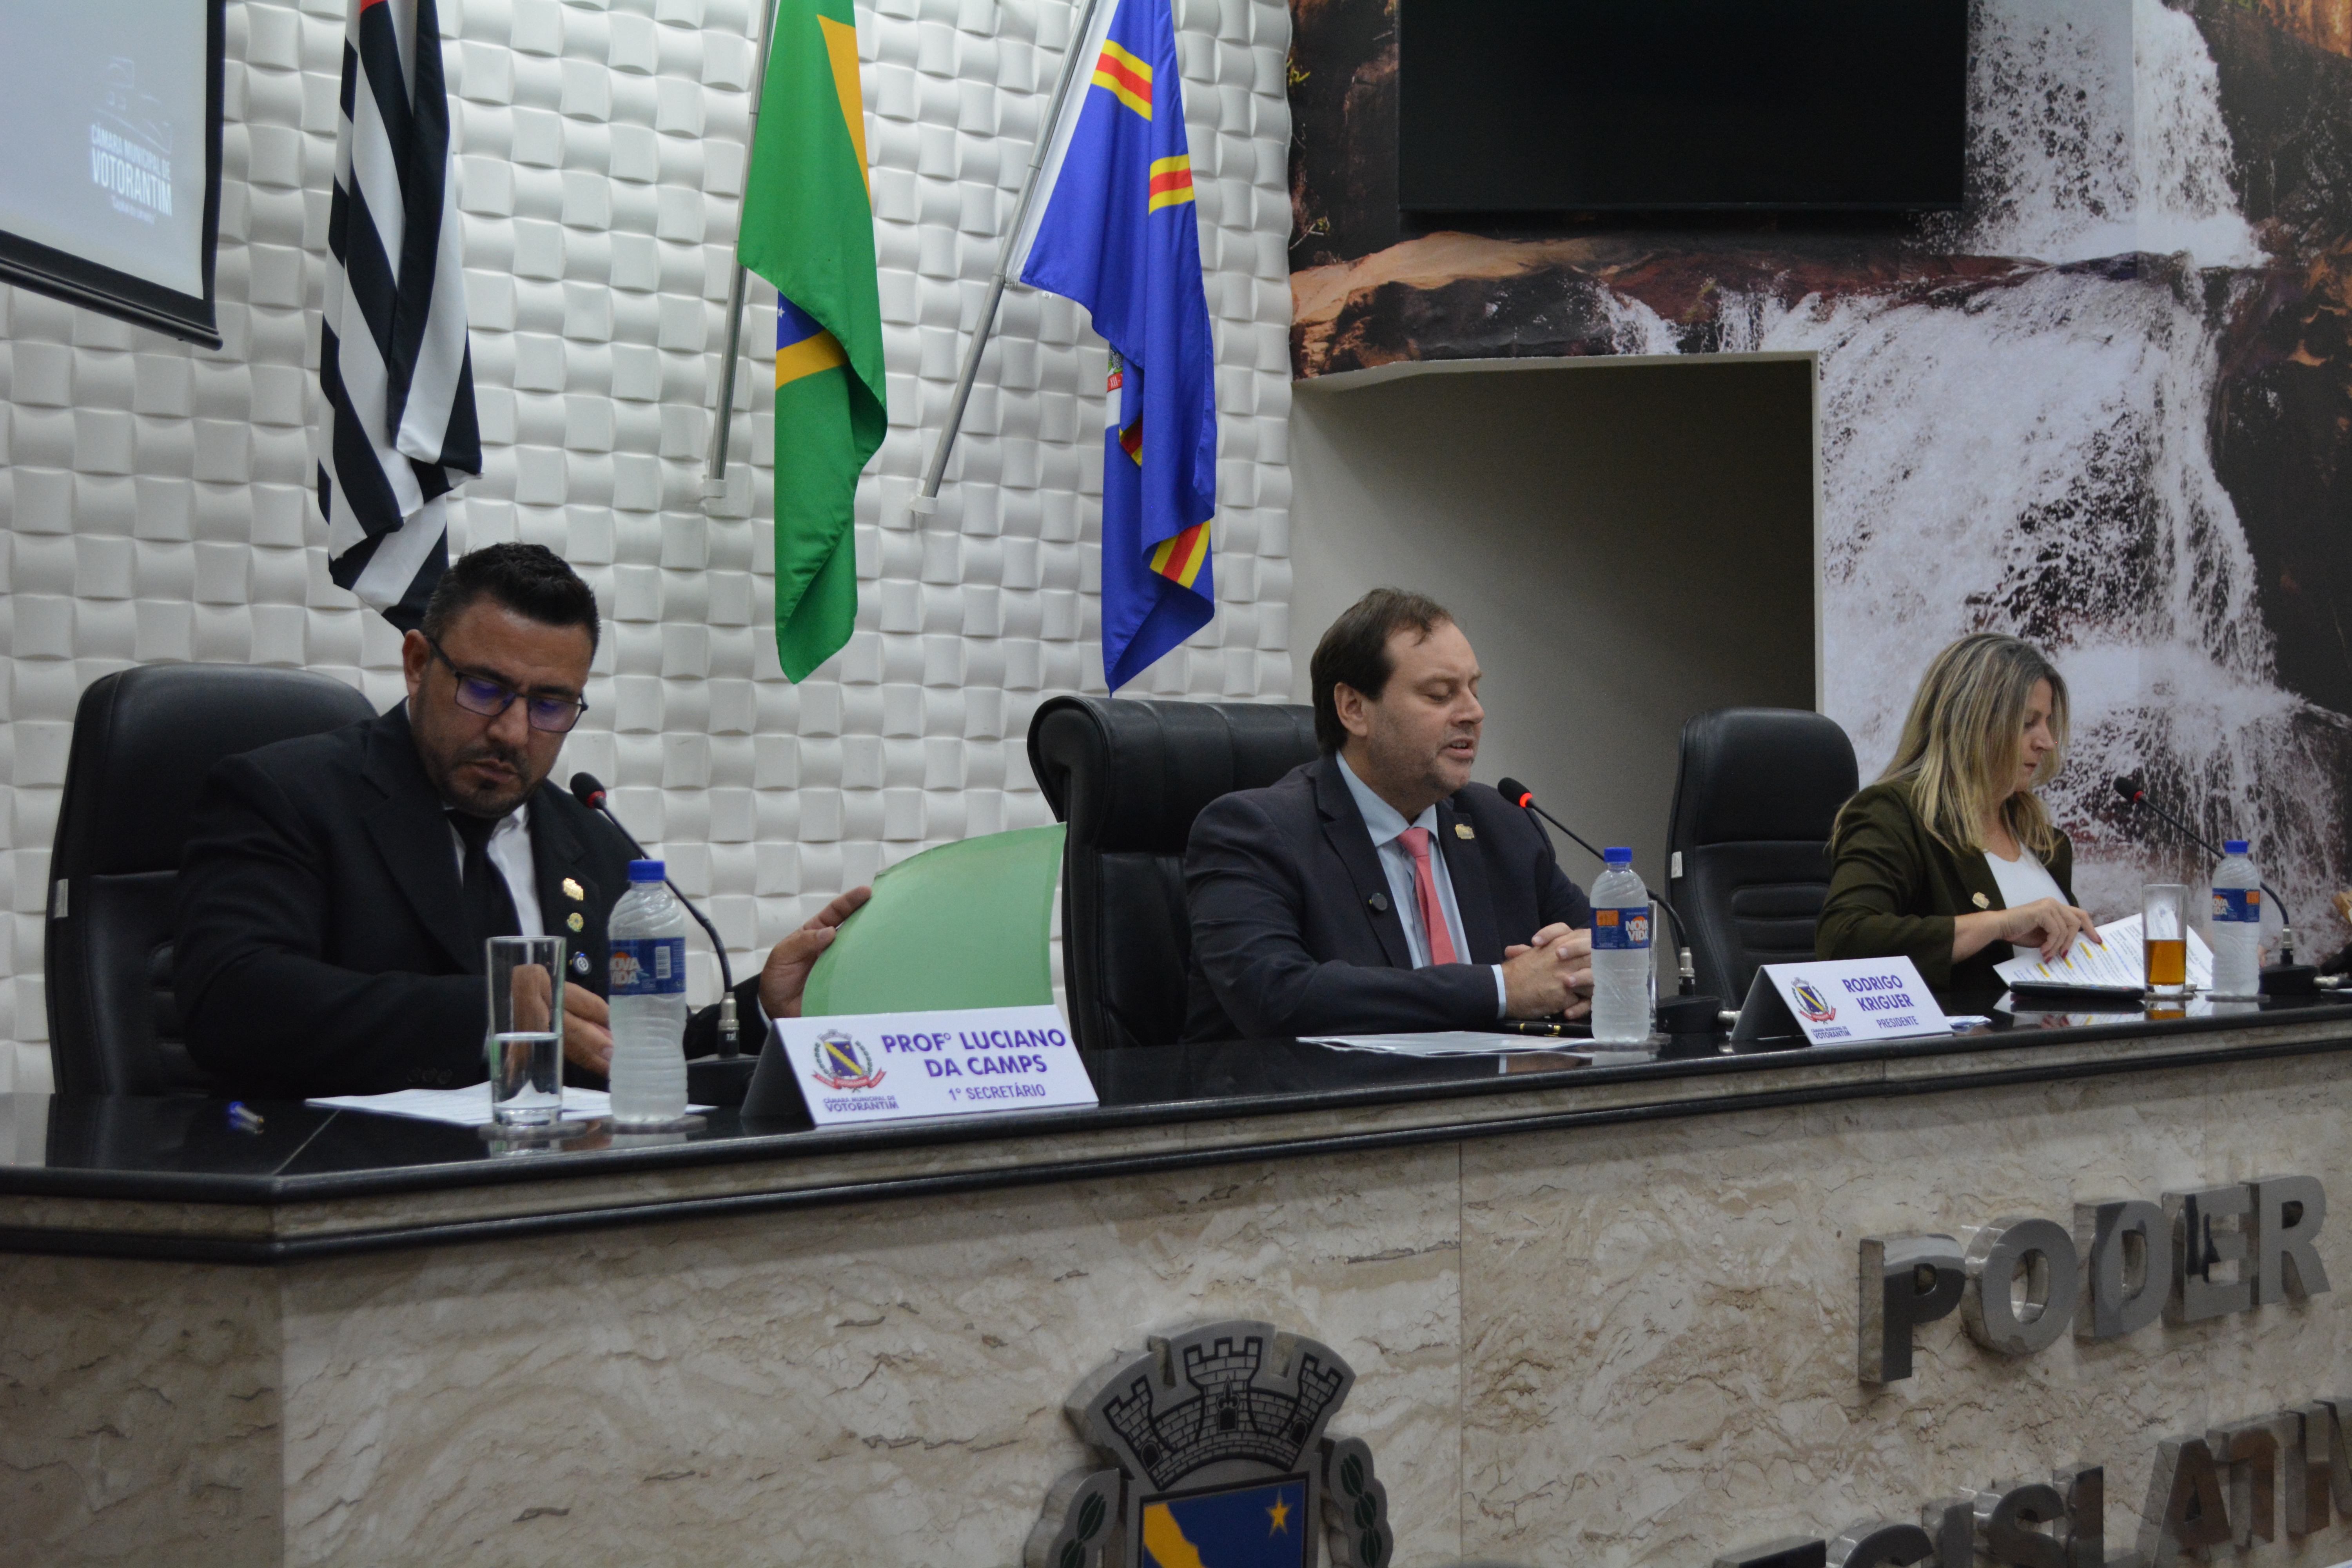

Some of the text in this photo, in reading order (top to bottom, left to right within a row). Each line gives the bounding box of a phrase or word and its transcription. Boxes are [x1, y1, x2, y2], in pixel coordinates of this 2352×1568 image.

[91, 122, 123, 156] CÂMARA
[91, 146, 172, 217] VOTORANTIM
[1841, 974, 1903, 993] RODRIGO
[1855, 993, 1915, 1011] KRIGUER
[1876, 1016, 1919, 1029] PRESIDENTE
[958, 1028, 1066, 1050] LUCIANO
[1813, 1030, 1851, 1039] VOTORANTIM
[924, 1054, 1048, 1077] DA CAMPS
[965, 1082, 1046, 1100] SECRETÁRIO
[824, 1100, 900, 1112] VOTORANTIM
[1858, 1174, 2332, 1383] PODER
